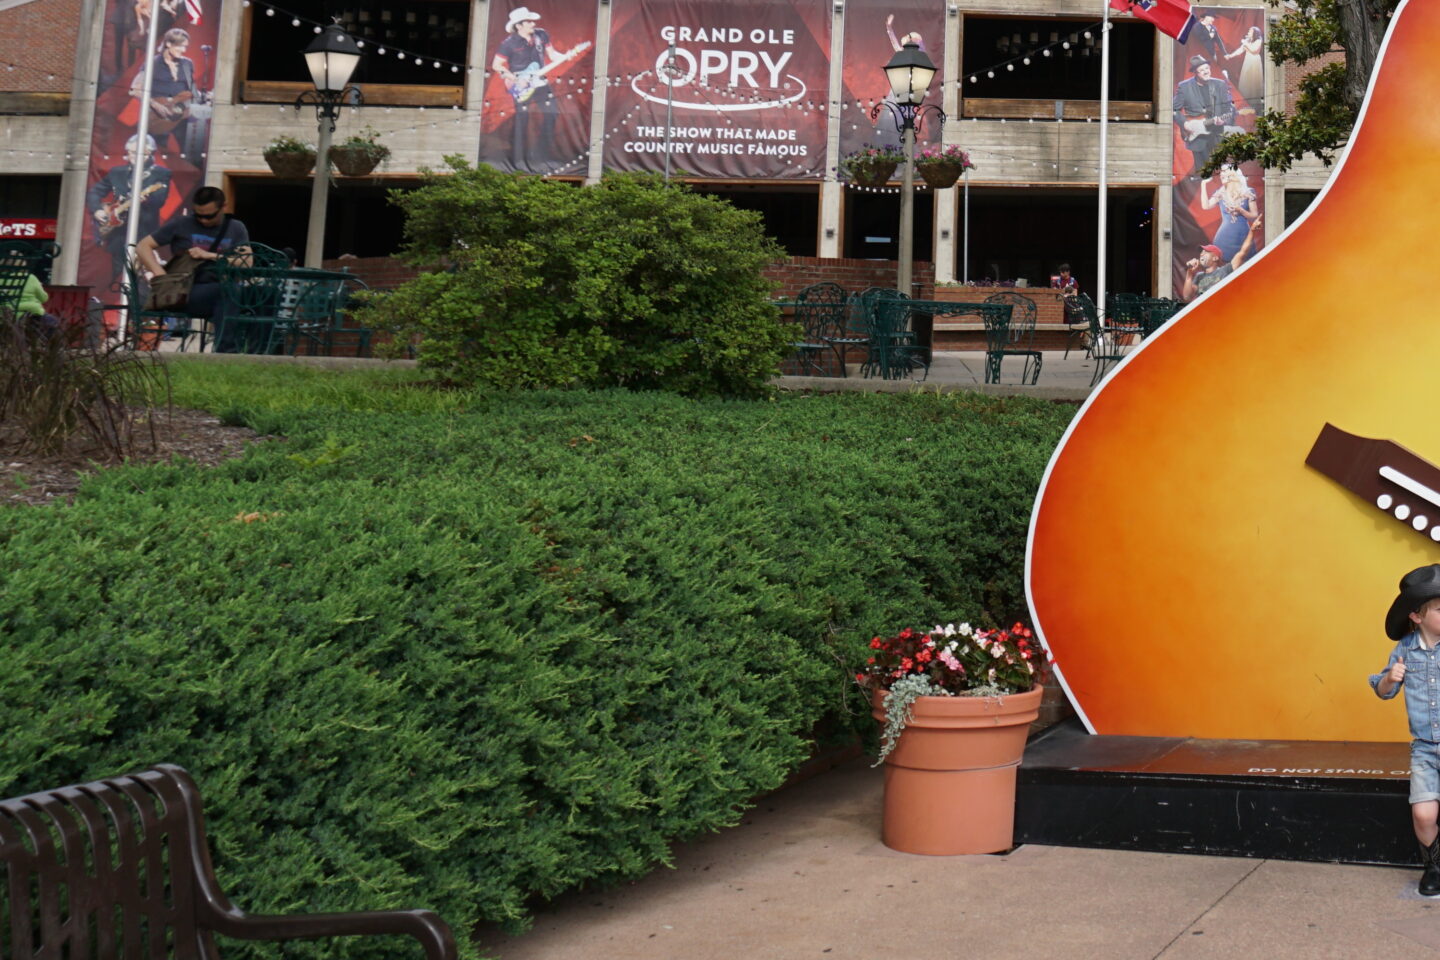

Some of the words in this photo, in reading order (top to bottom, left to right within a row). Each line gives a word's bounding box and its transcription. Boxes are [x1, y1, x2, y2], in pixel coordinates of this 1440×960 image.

[660, 26, 743, 44] GRAND
[750, 29, 795, 44] OLE
[655, 47, 793, 89] OPRY
[636, 126, 665, 138] THE
[669, 127, 712, 138] SHOW
[716, 127, 752, 139] THAT
[755, 129, 797, 140] MADE
[624, 141, 694, 154] COUNTRY
[697, 143, 744, 155] MUSIC
[748, 143, 808, 156] FAMOUS
